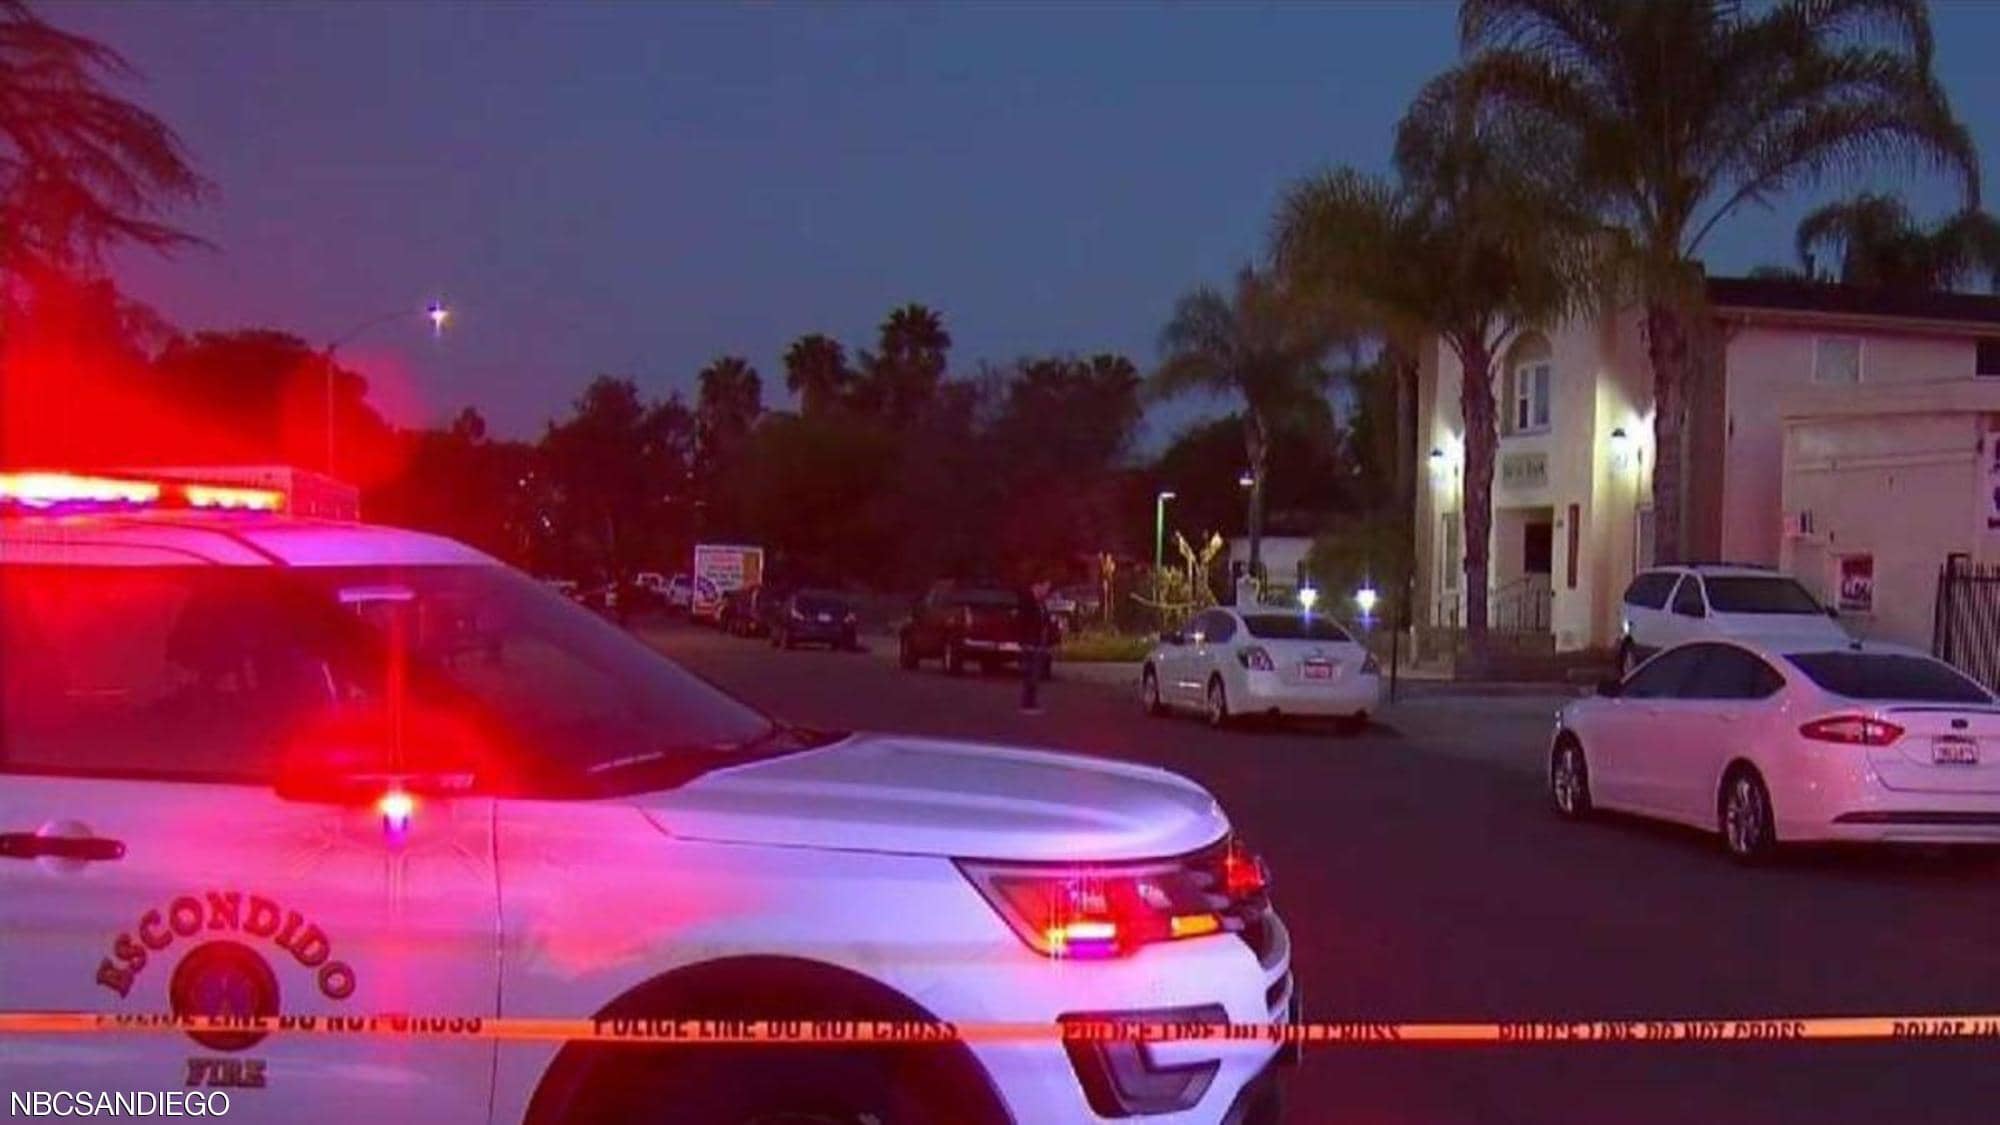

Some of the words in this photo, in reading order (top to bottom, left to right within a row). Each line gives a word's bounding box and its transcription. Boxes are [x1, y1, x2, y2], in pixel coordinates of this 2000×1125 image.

[96, 891, 357, 1000] ESCONDIDO
[594, 1018, 689, 1038] POLICE
[699, 1019, 757, 1038] LINE
[767, 1020, 801, 1038] DO
[186, 1058, 267, 1088] FIRE
